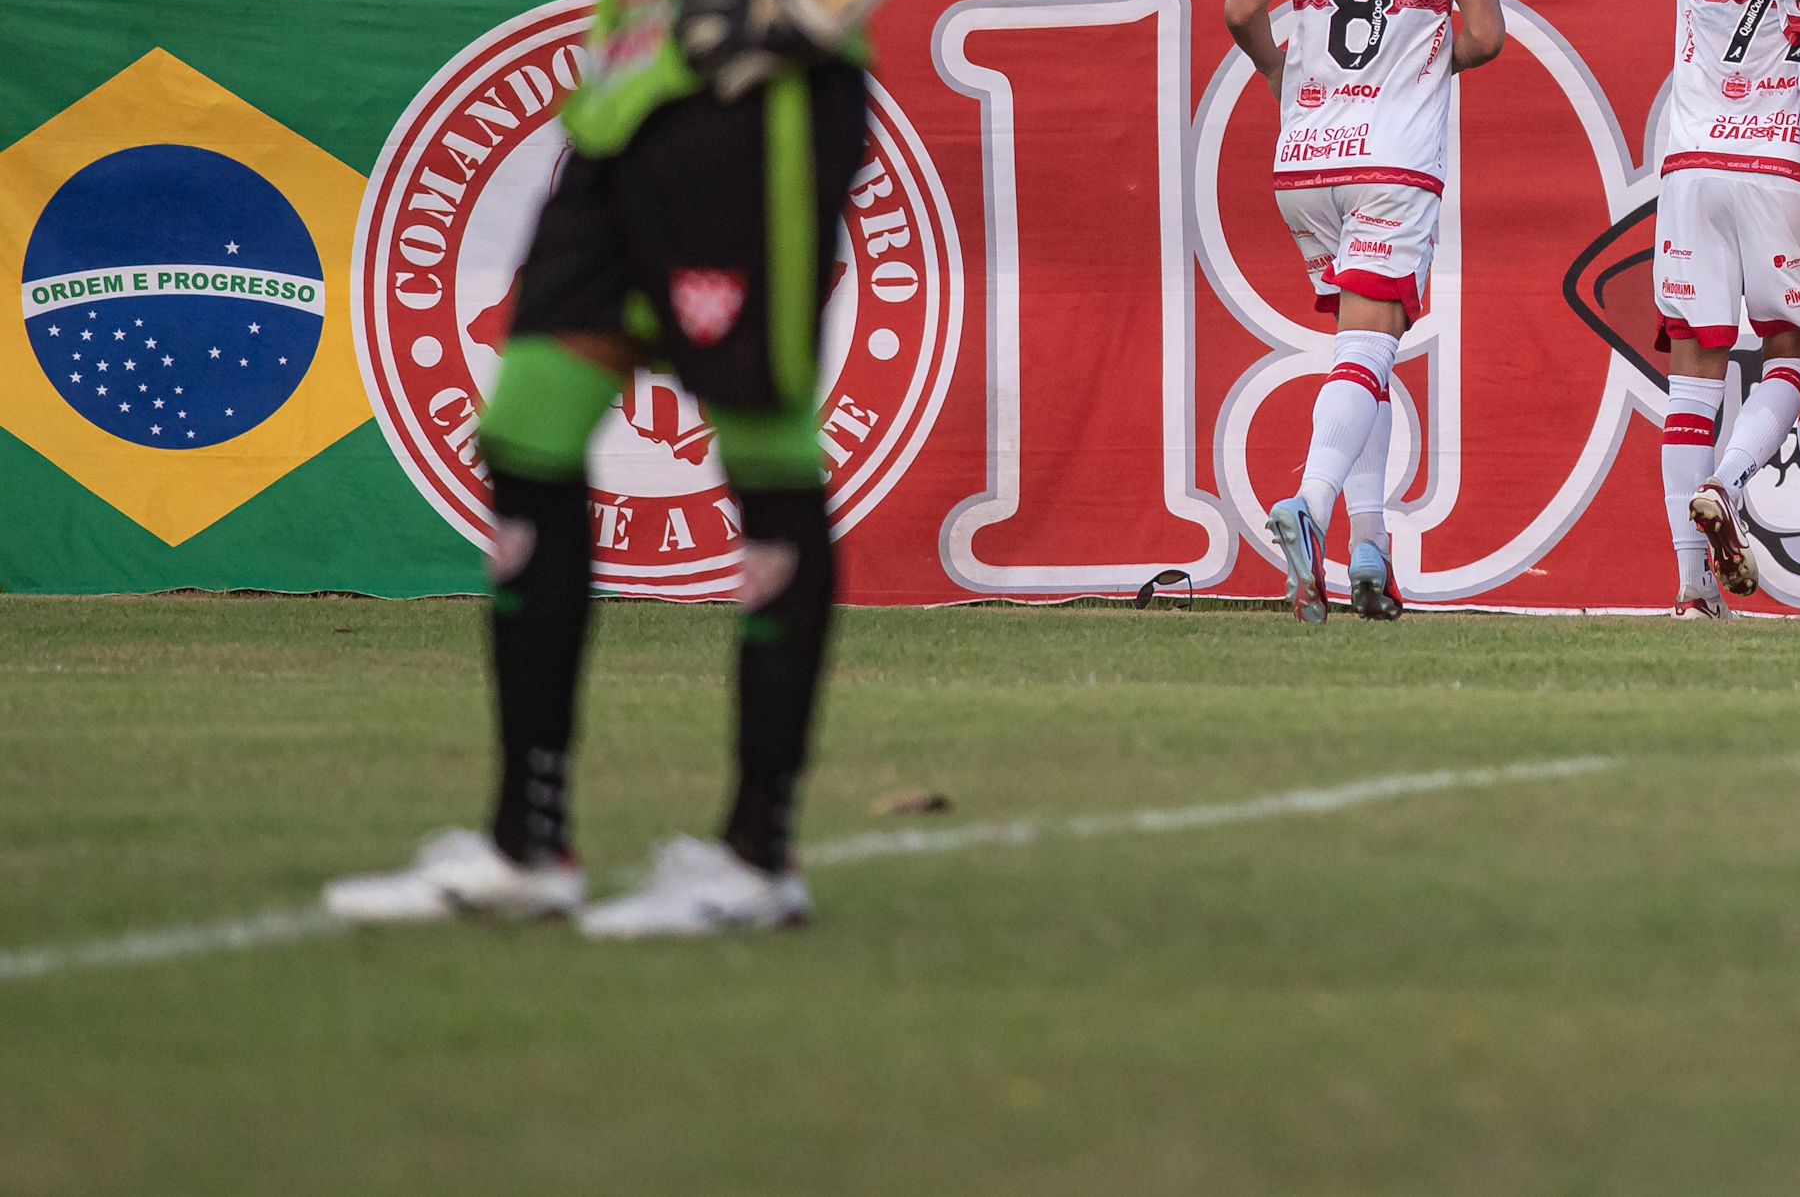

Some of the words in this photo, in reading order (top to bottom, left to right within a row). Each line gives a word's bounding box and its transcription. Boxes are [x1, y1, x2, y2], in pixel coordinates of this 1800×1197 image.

[1323, 122, 1370, 142] SÓCIO
[31, 273, 125, 306] ORDEM
[132, 273, 148, 293] E
[156, 271, 317, 306] PROGRESSO
[659, 507, 696, 553] A
